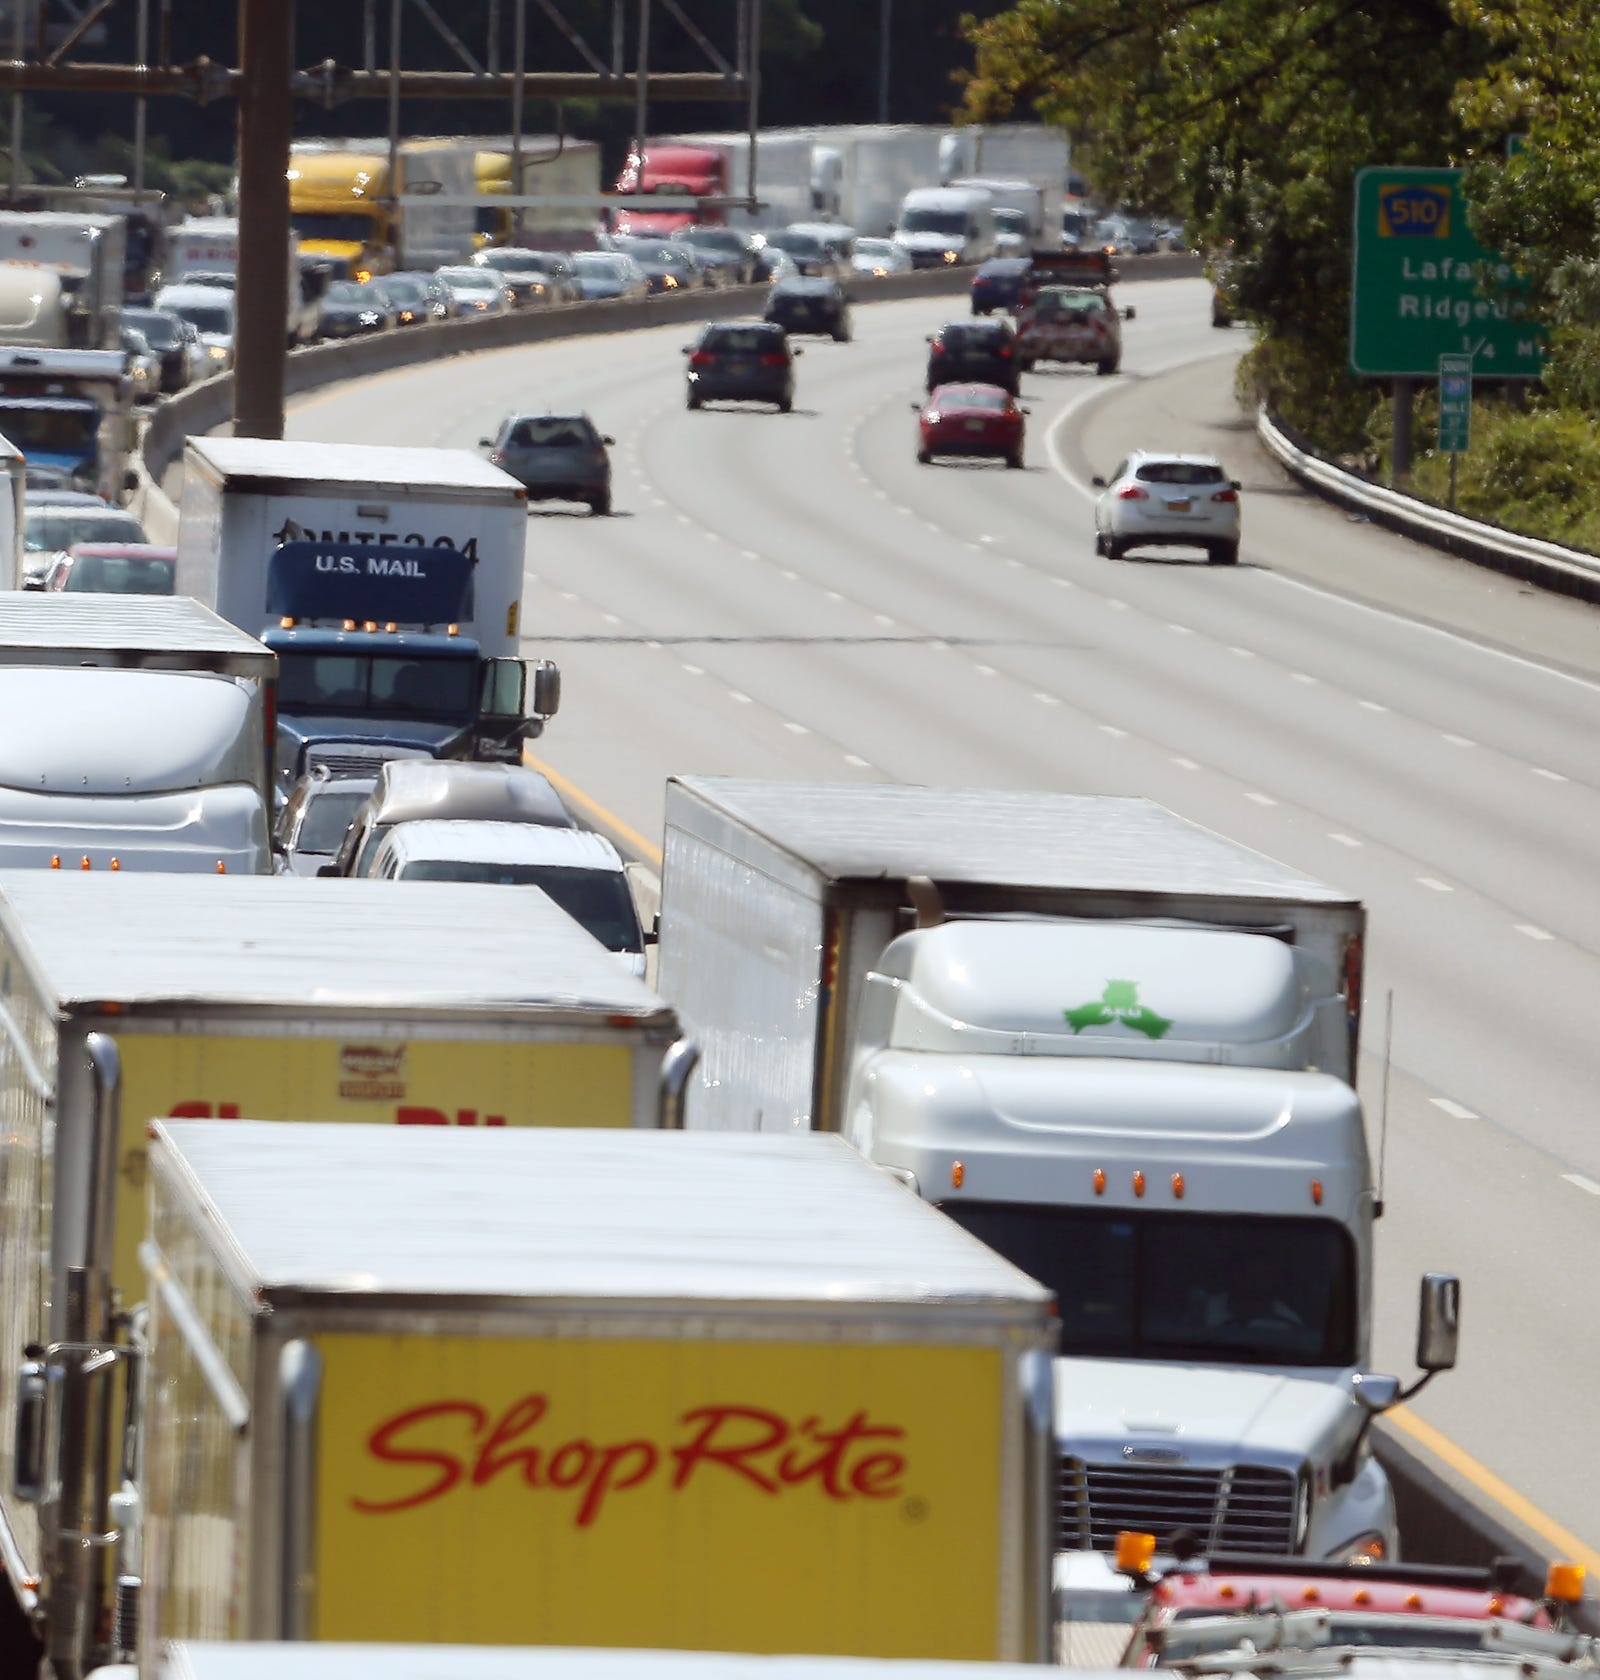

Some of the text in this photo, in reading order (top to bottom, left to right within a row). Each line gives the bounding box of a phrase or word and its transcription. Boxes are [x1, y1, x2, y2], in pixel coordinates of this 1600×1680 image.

[1392, 199, 1438, 225] 510
[315, 555, 426, 578] U.S. MAIL
